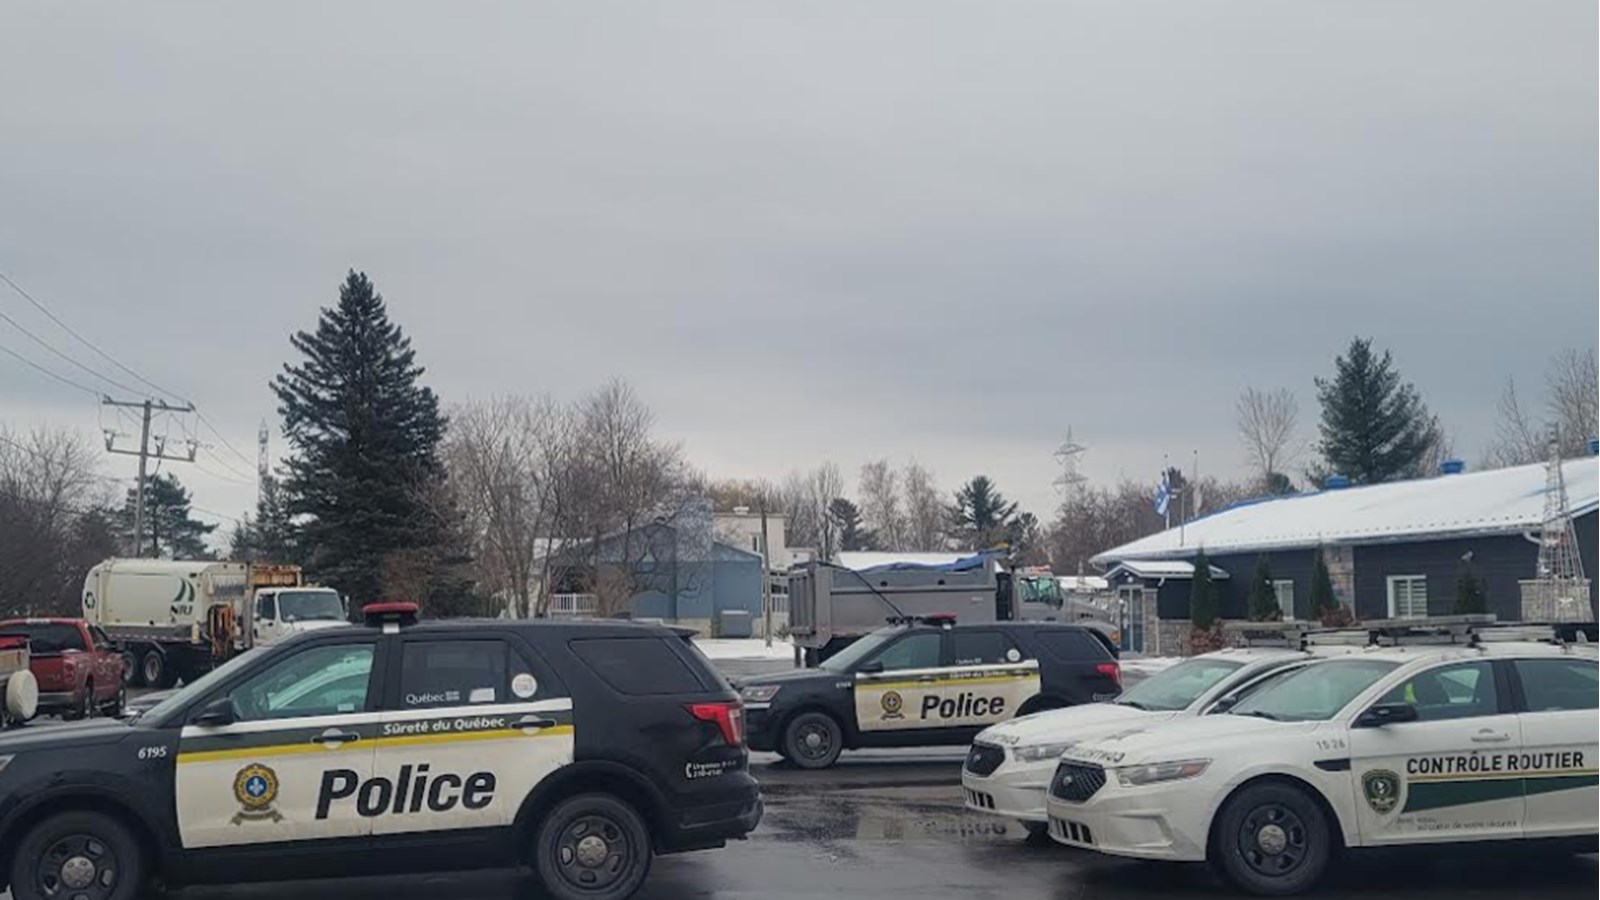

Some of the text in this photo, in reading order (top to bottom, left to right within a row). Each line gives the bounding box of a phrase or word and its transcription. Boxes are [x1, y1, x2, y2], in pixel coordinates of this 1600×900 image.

[405, 692, 445, 705] Québec
[920, 692, 1005, 720] Police
[383, 717, 505, 735] Sûreté du Québec
[138, 746, 167, 759] 6195
[1407, 751, 1584, 774] CONTRÔLE ROUTIER
[315, 763, 497, 820] Police
